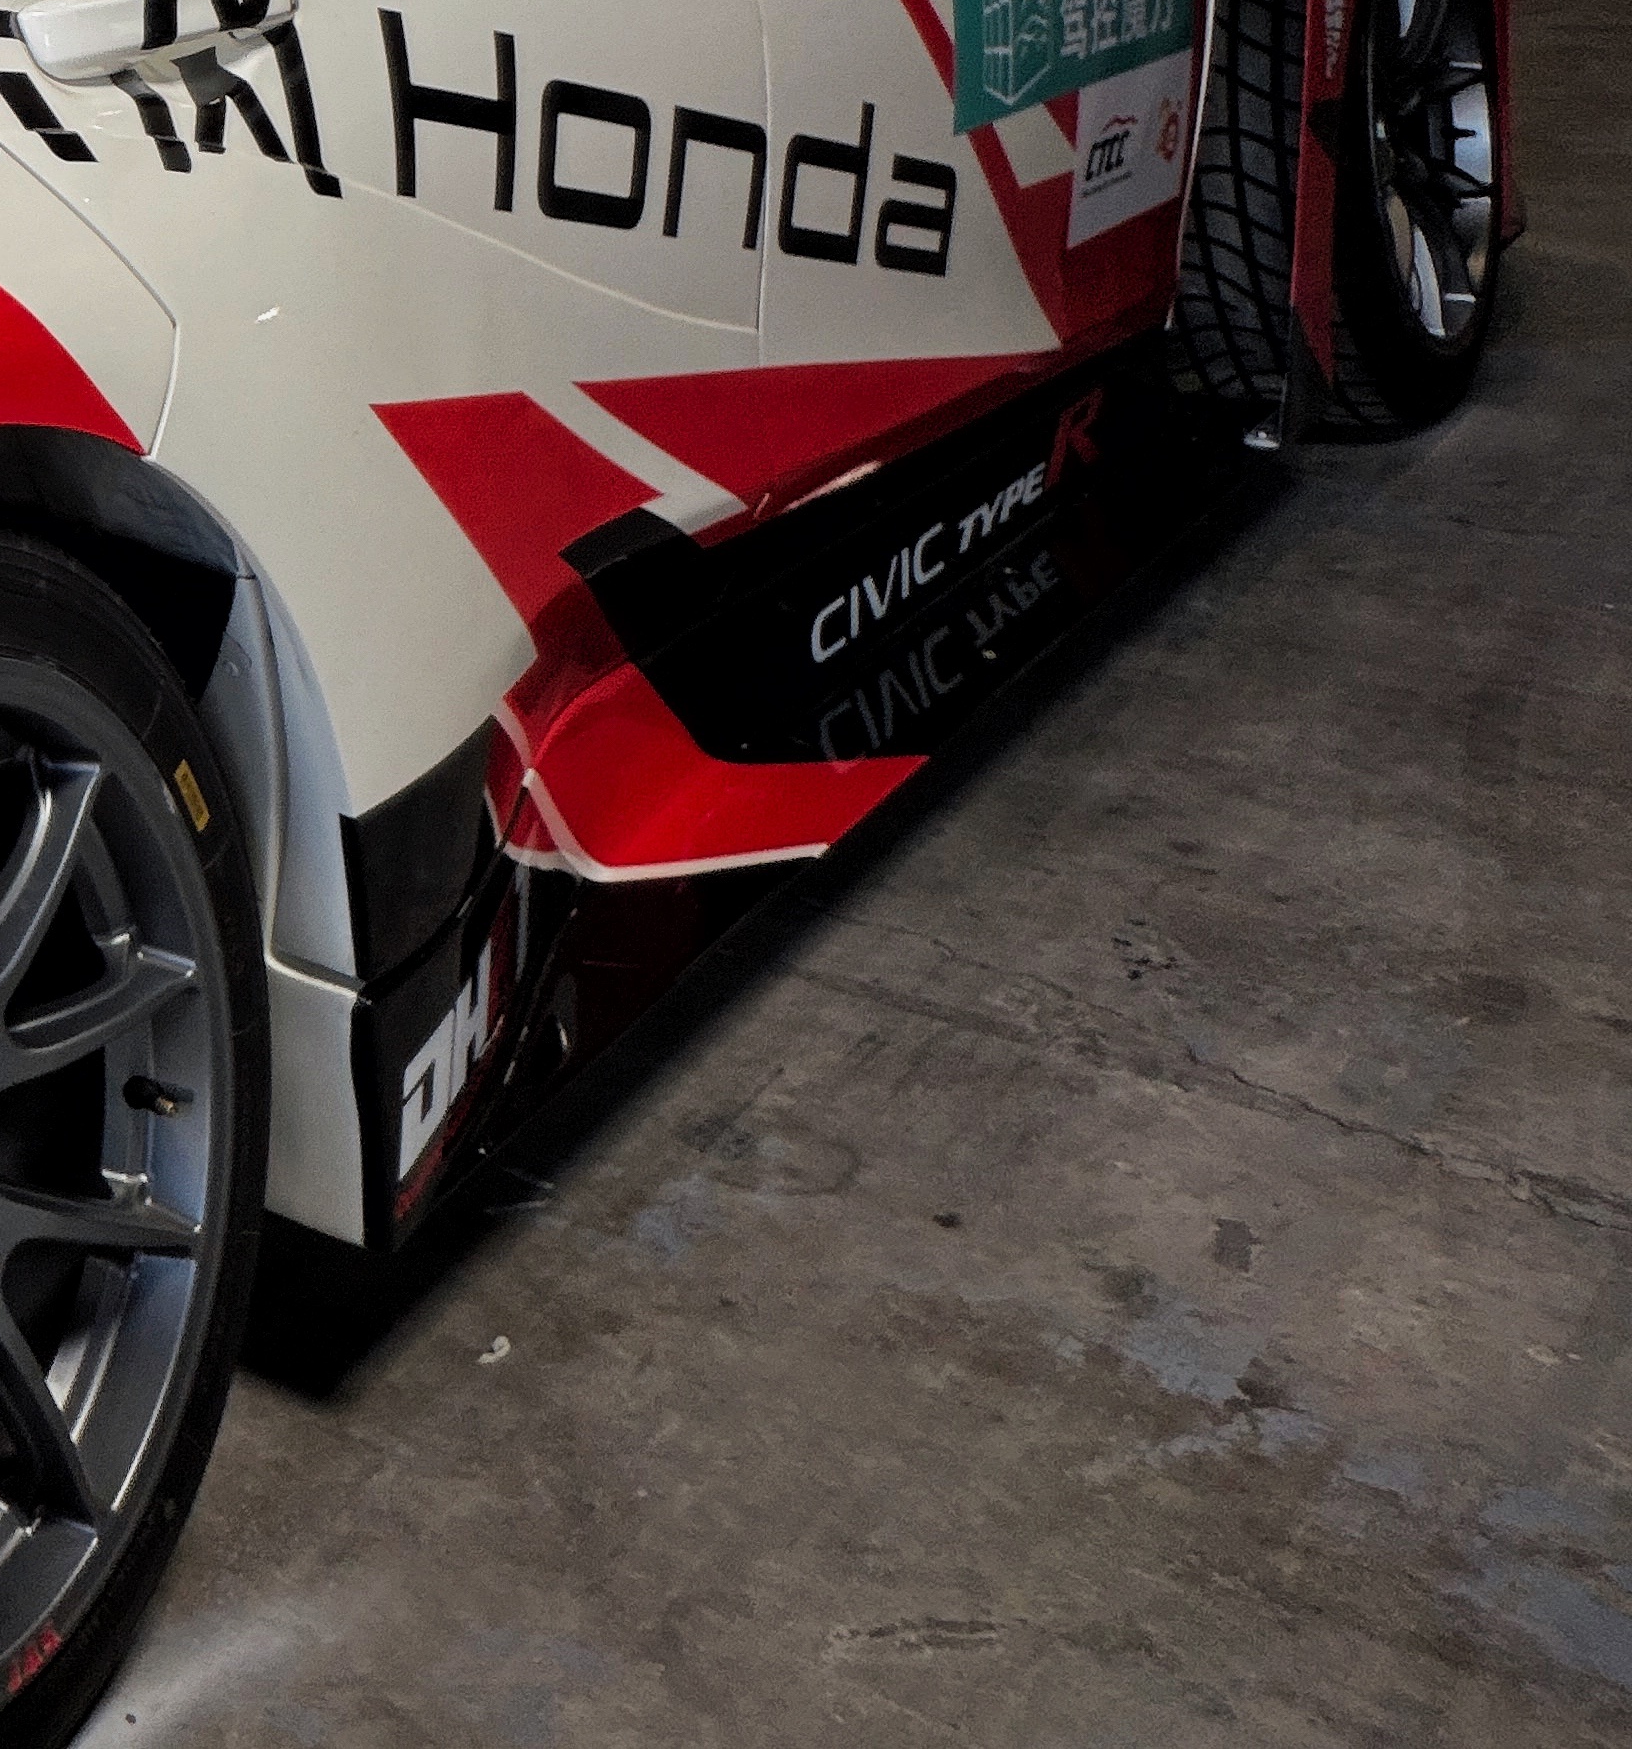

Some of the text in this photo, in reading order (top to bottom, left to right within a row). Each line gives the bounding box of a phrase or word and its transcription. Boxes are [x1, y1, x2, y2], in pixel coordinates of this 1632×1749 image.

[378, 7, 957, 277] Honda
[811, 387, 1103, 663] CIVIC TYPE R
